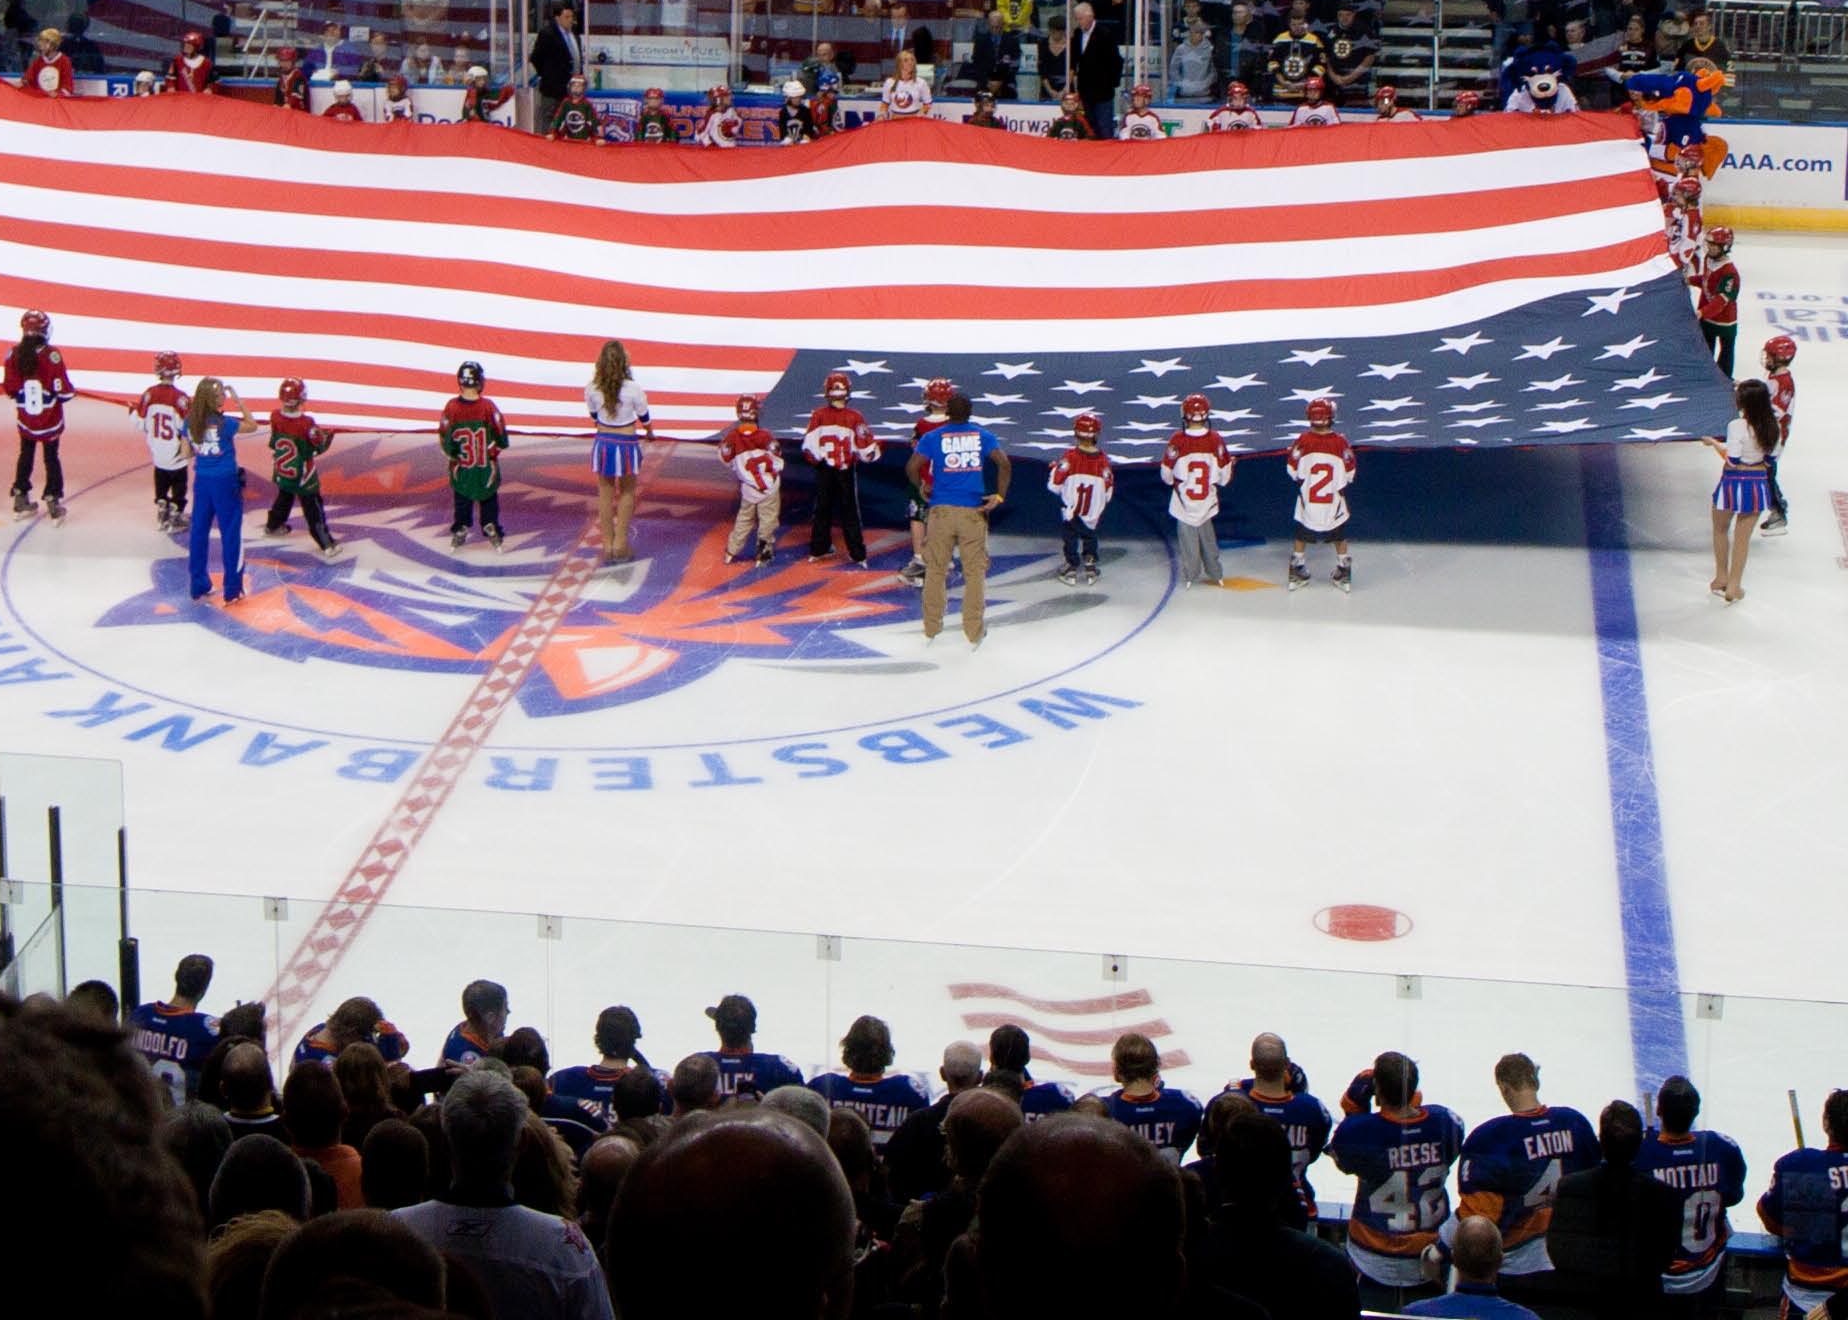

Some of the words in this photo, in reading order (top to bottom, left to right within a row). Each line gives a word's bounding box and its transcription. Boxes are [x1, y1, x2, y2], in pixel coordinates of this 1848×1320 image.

[999, 117, 1052, 136] Norwa
[1721, 151, 1833, 173] AAA.com
[24, 379, 44, 415] 8
[152, 412, 174, 441] 15
[274, 438, 298, 478] 2
[452, 428, 488, 468] 31
[941, 435, 981, 453] GAME
[944, 451, 980, 468] OPS
[1187, 461, 1210, 501] 3
[1309, 463, 1334, 504] 2
[43, 691, 426, 783] BANK
[484, 687, 1146, 792] WEBSTER
[132, 1027, 189, 1059] NDOLFO
[1388, 1142, 1441, 1167] REESE
[1524, 1130, 1574, 1161] EATON
[1653, 1163, 1718, 1188] MOTTAU
